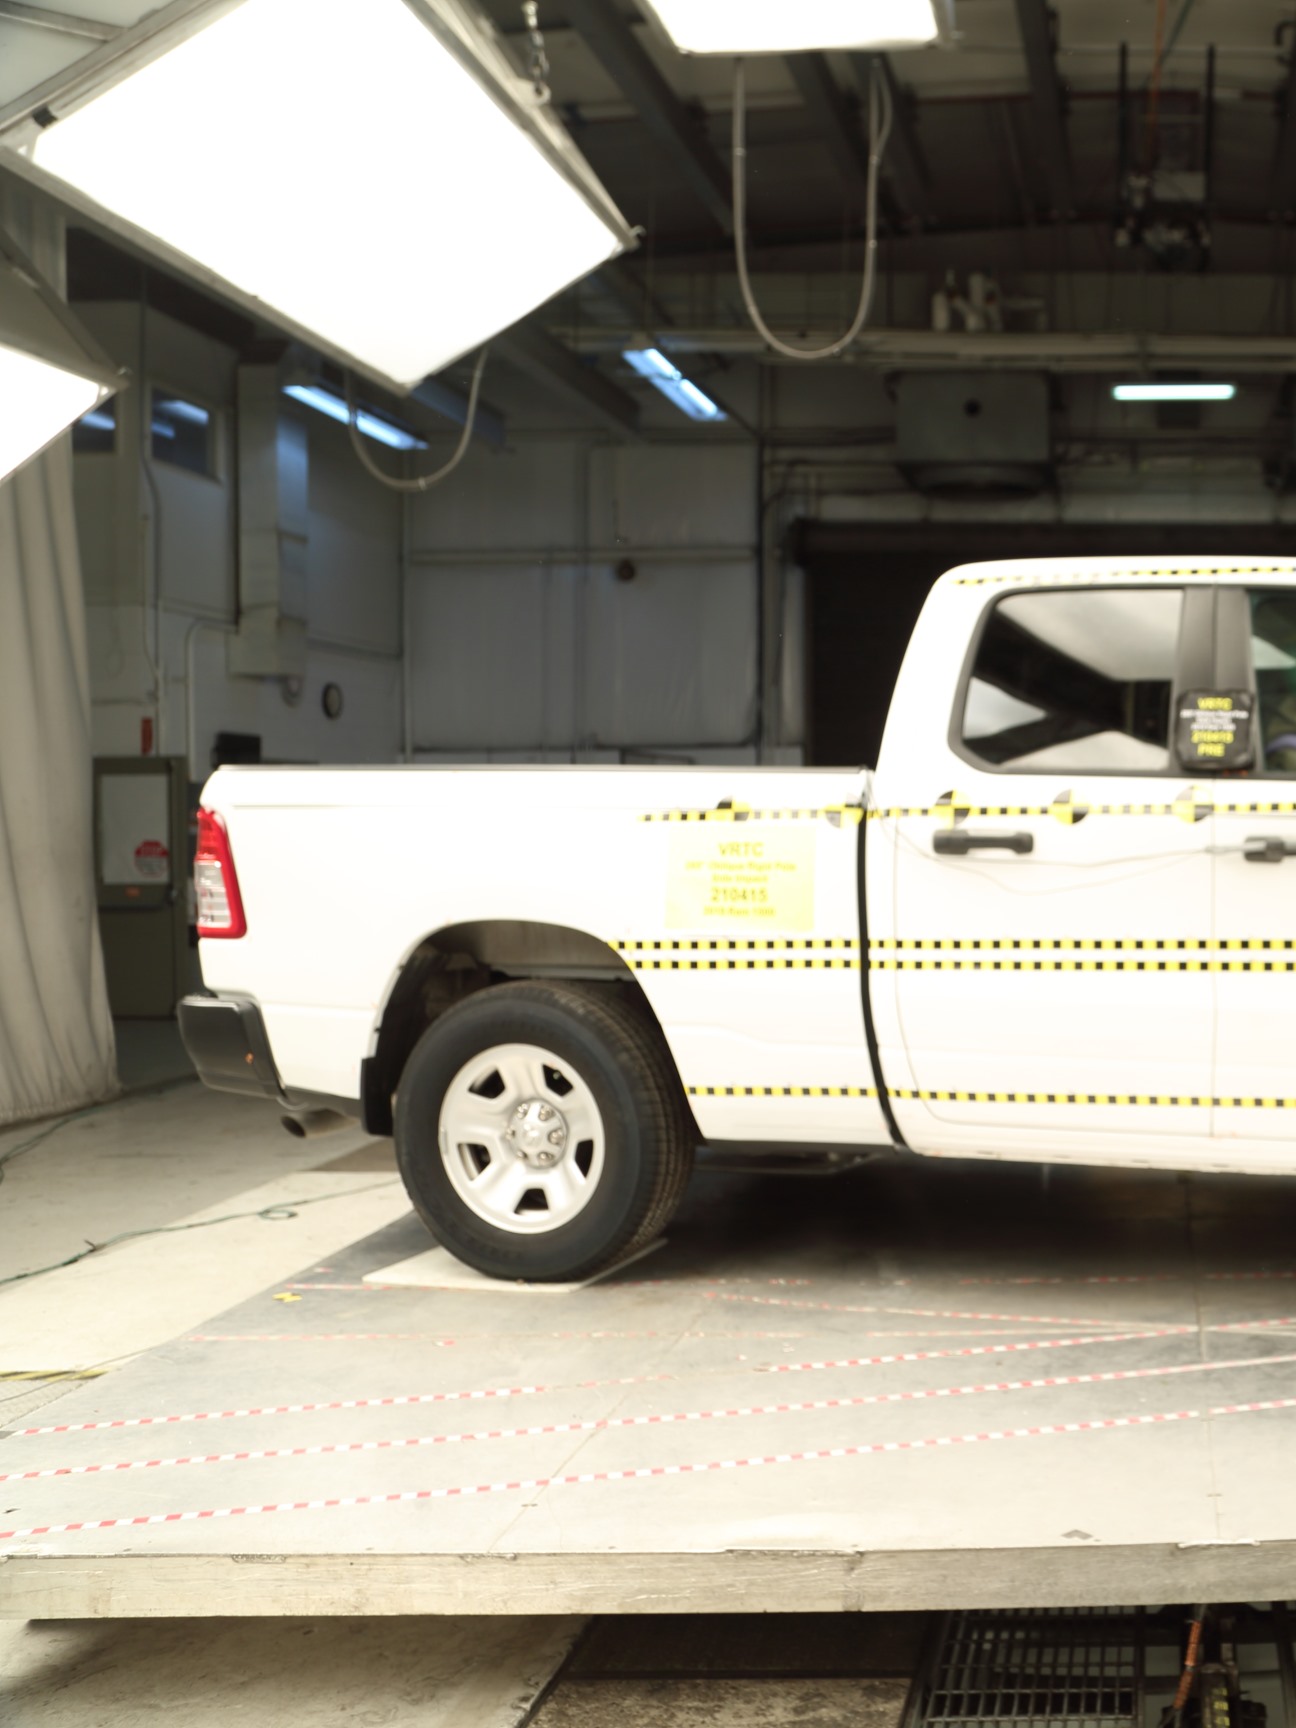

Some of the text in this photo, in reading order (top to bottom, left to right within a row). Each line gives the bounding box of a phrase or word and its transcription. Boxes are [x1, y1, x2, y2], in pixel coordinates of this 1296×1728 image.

[1197, 743, 1226, 757] PRE
[719, 842, 764, 857] VRTC
[710, 886, 769, 903] 210415
